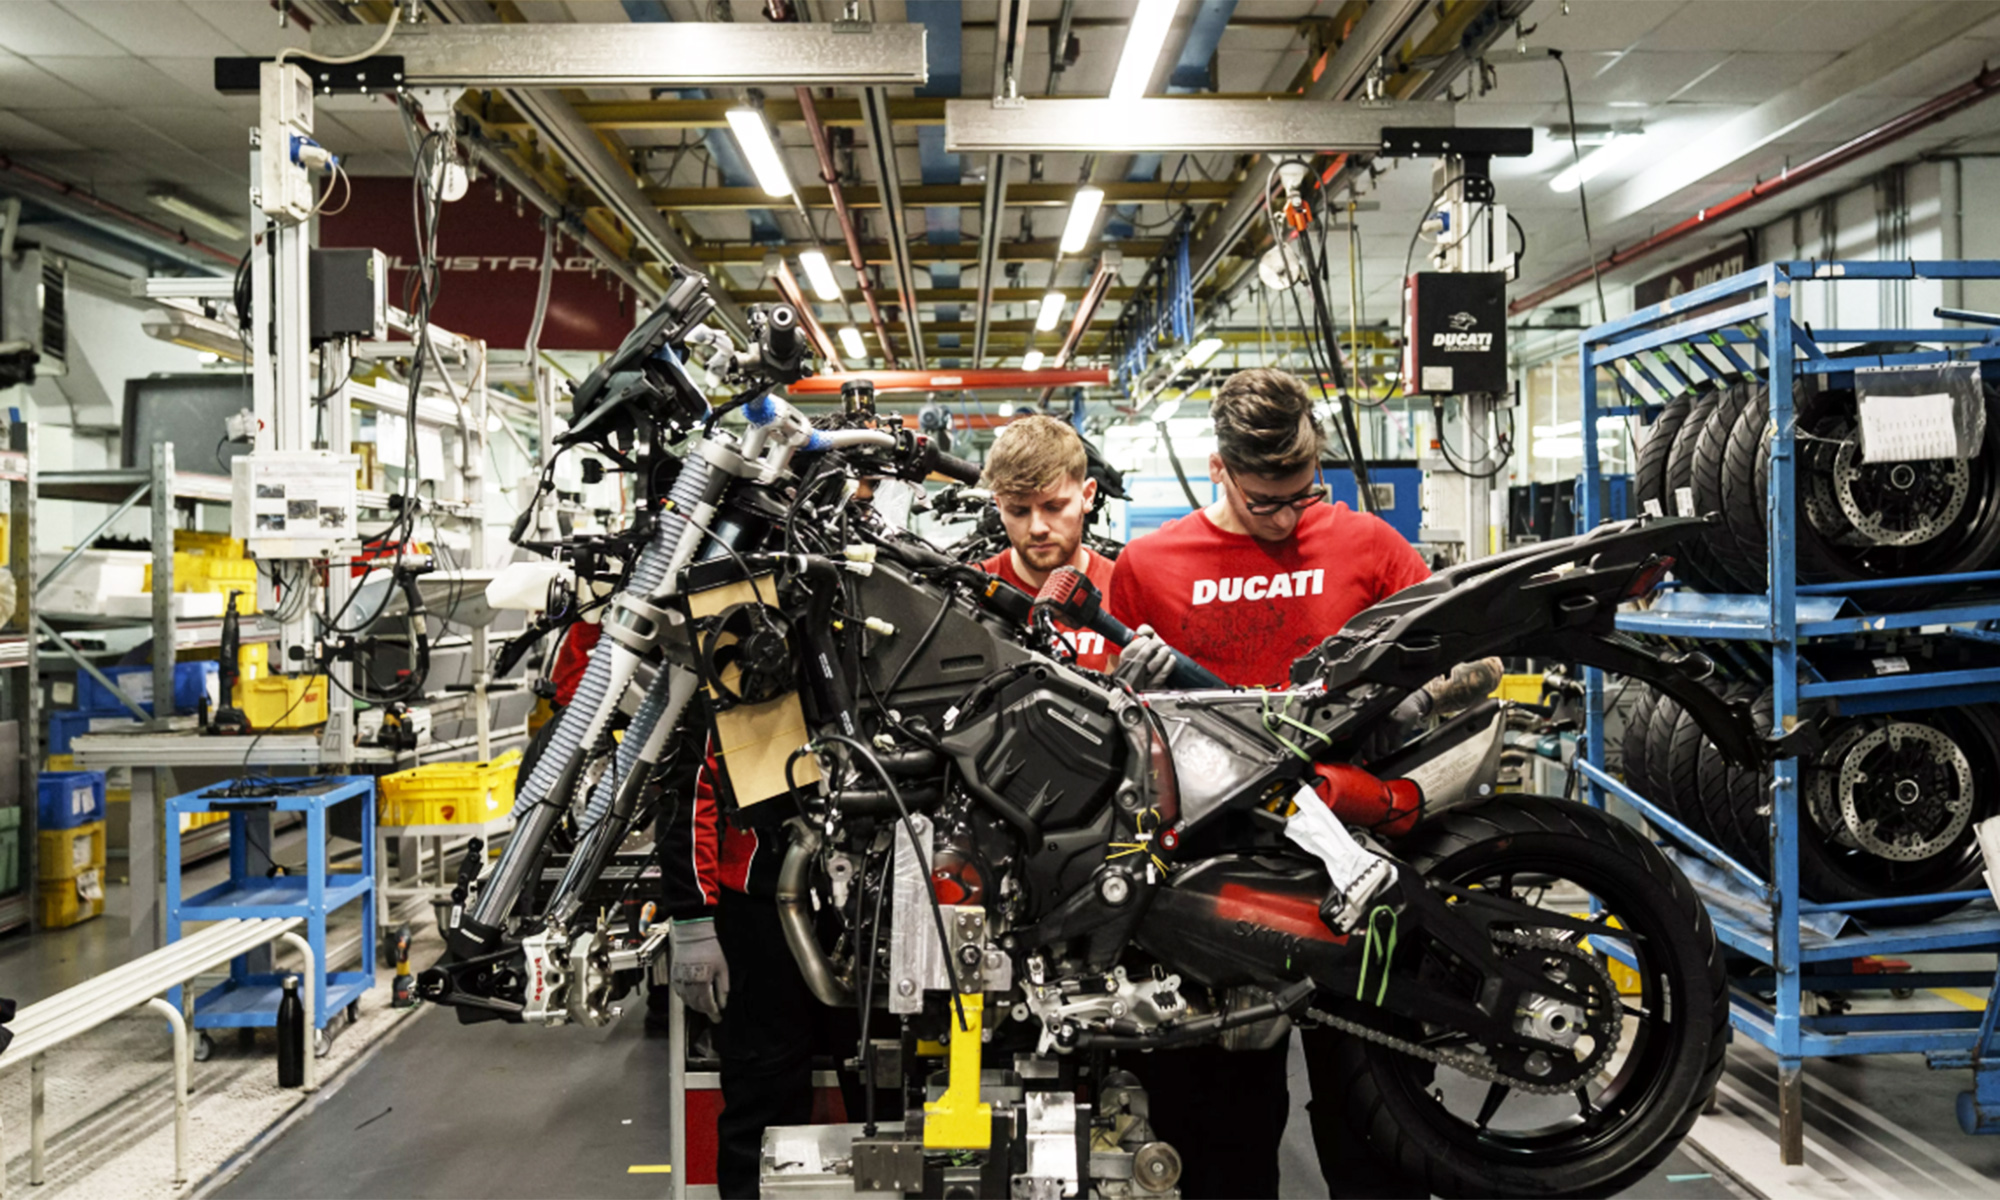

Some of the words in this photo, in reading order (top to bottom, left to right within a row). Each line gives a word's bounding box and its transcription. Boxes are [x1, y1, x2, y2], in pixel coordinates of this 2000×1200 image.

[1432, 332, 1493, 347] DUCATI
[1192, 568, 1325, 605] DUCATI
[534, 956, 545, 1002] brembo
